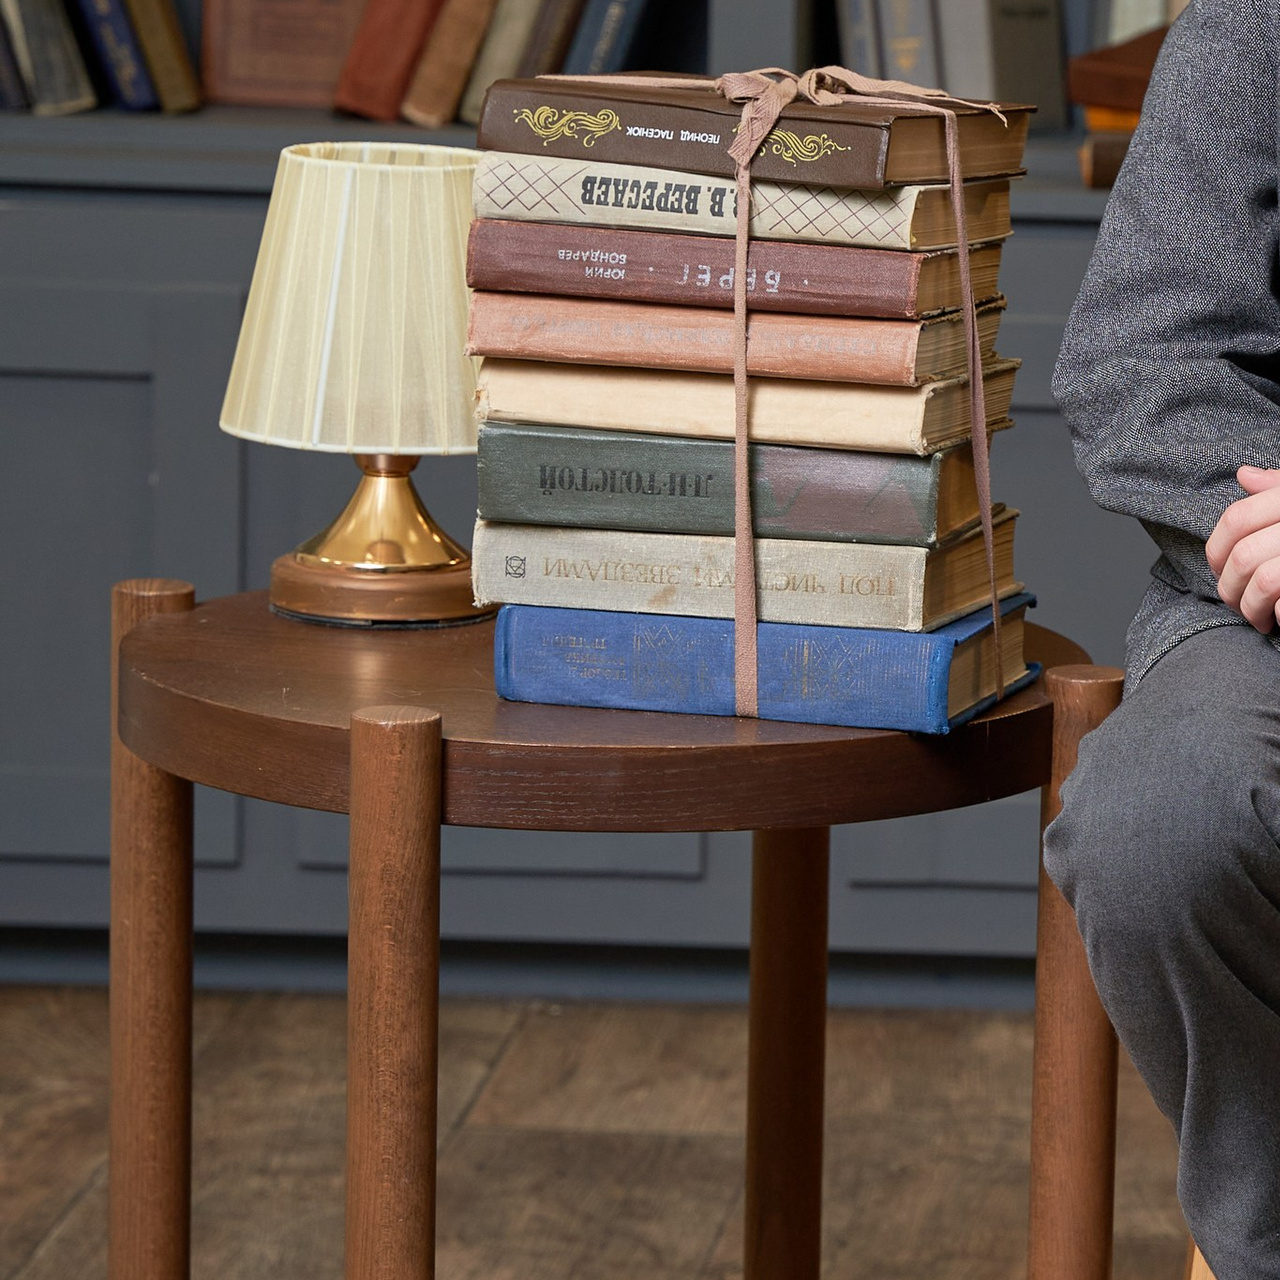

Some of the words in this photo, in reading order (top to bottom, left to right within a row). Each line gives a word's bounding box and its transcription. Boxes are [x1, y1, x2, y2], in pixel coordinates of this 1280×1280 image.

[626, 126, 675, 140] ПАСЕНЮК
[580, 175, 702, 215] ВЕРЕСАЕВ
[707, 185, 727, 218] В.
[557, 249, 628, 264] БОНДАРЕВ
[585, 266, 626, 280] ЮРИЙ
[542, 556, 682, 585] ЗВЕЗДАМИ
[693, 565, 828, 594] ЧИСТМИ
[838, 572, 897, 596] ПОД
